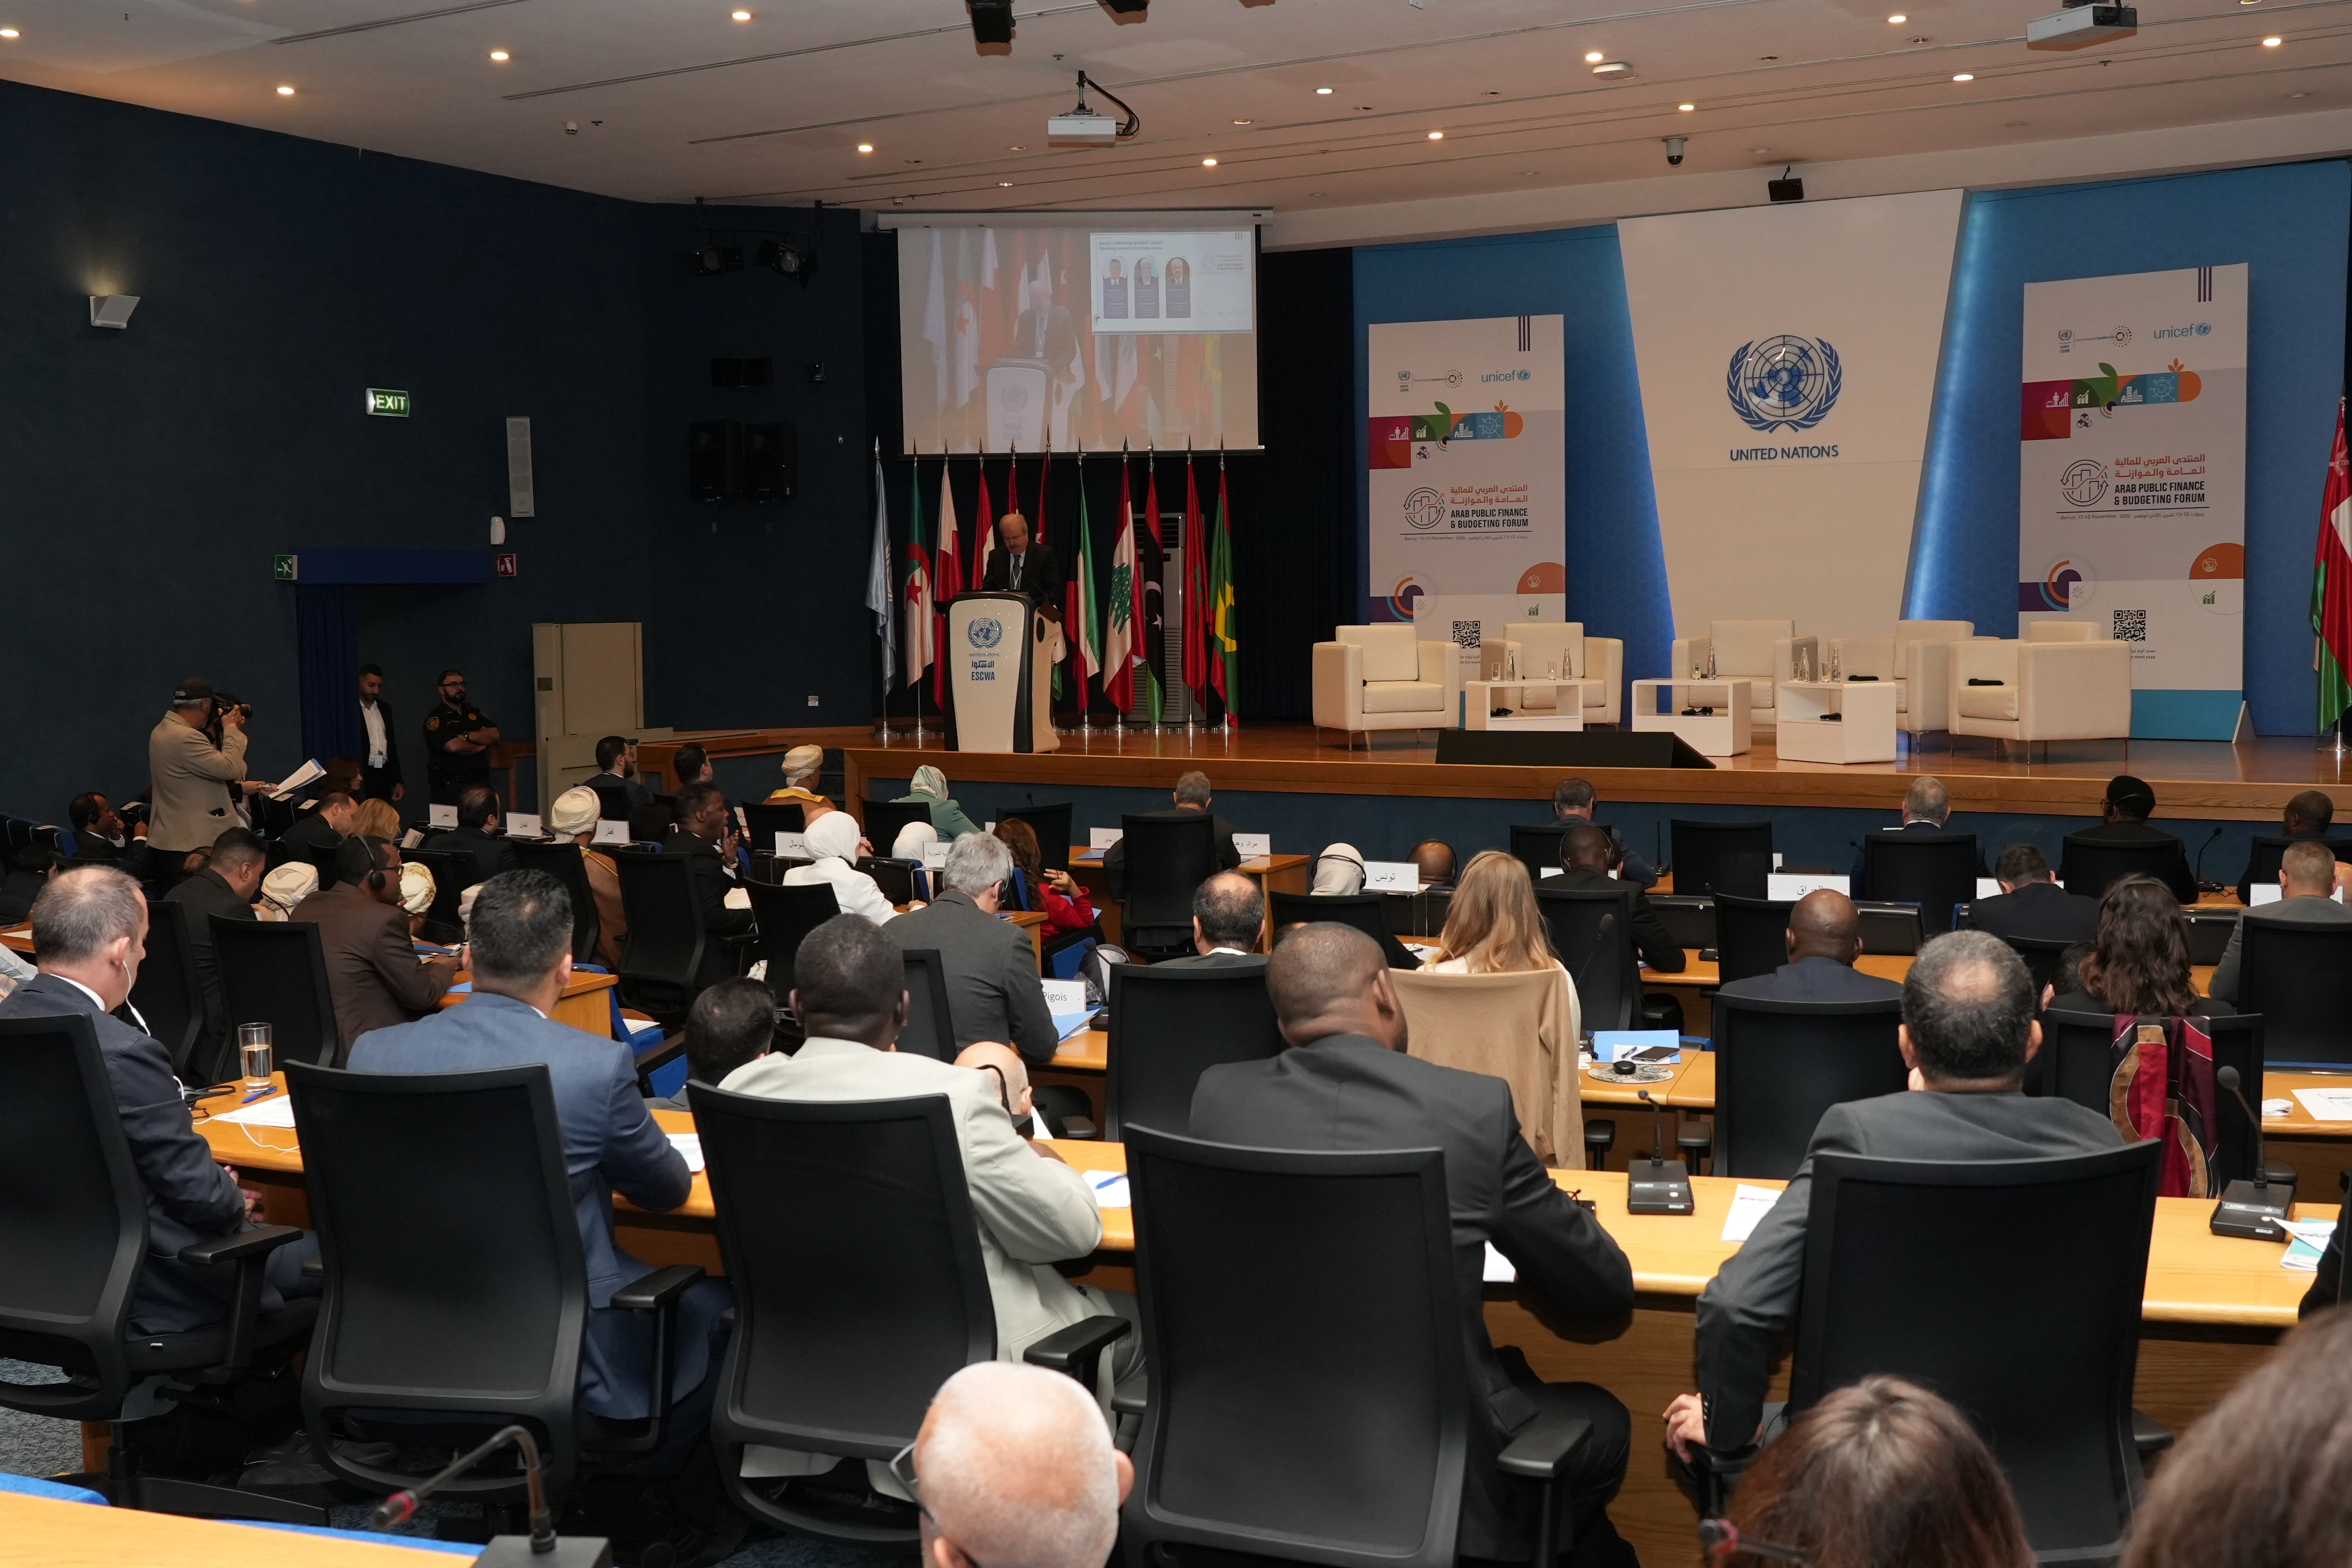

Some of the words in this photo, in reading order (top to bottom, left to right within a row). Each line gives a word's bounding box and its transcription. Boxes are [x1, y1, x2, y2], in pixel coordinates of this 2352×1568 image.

[2154, 324, 2194, 339] unicef
[1481, 371, 1517, 382] unicef
[376, 395, 406, 410] EXIT
[1730, 448, 1778, 460] UNITED
[1781, 445, 1839, 458] NATIONS
[2115, 457, 2141, 467] للمالية
[2144, 455, 2170, 468] العربي
[2173, 454, 2205, 464] المنتدى
[1451, 486, 1473, 495] للمالية
[1475, 485, 1498, 496] العربي
[1500, 484, 1528, 493] المنتدى
[2115, 484, 2136, 494] ARAB
[2139, 483, 2167, 492] PUBLIC
[2170, 481, 2204, 492] FINANCE
[2115, 497, 2120, 505] &
[2123, 495, 2171, 505] BUDGETING
[2174, 494, 2204, 503] FORUM
[1451, 510, 1469, 518] ARAB
[1472, 509, 1496, 518] PUBLIC
[1498, 508, 1528, 517] FINANCE
[1458, 519, 1500, 528] BUDGETING
[1502, 519, 1528, 527] FORUM
[971, 672, 995, 681] ESCWA
[1375, 873, 1395, 882] تونس
